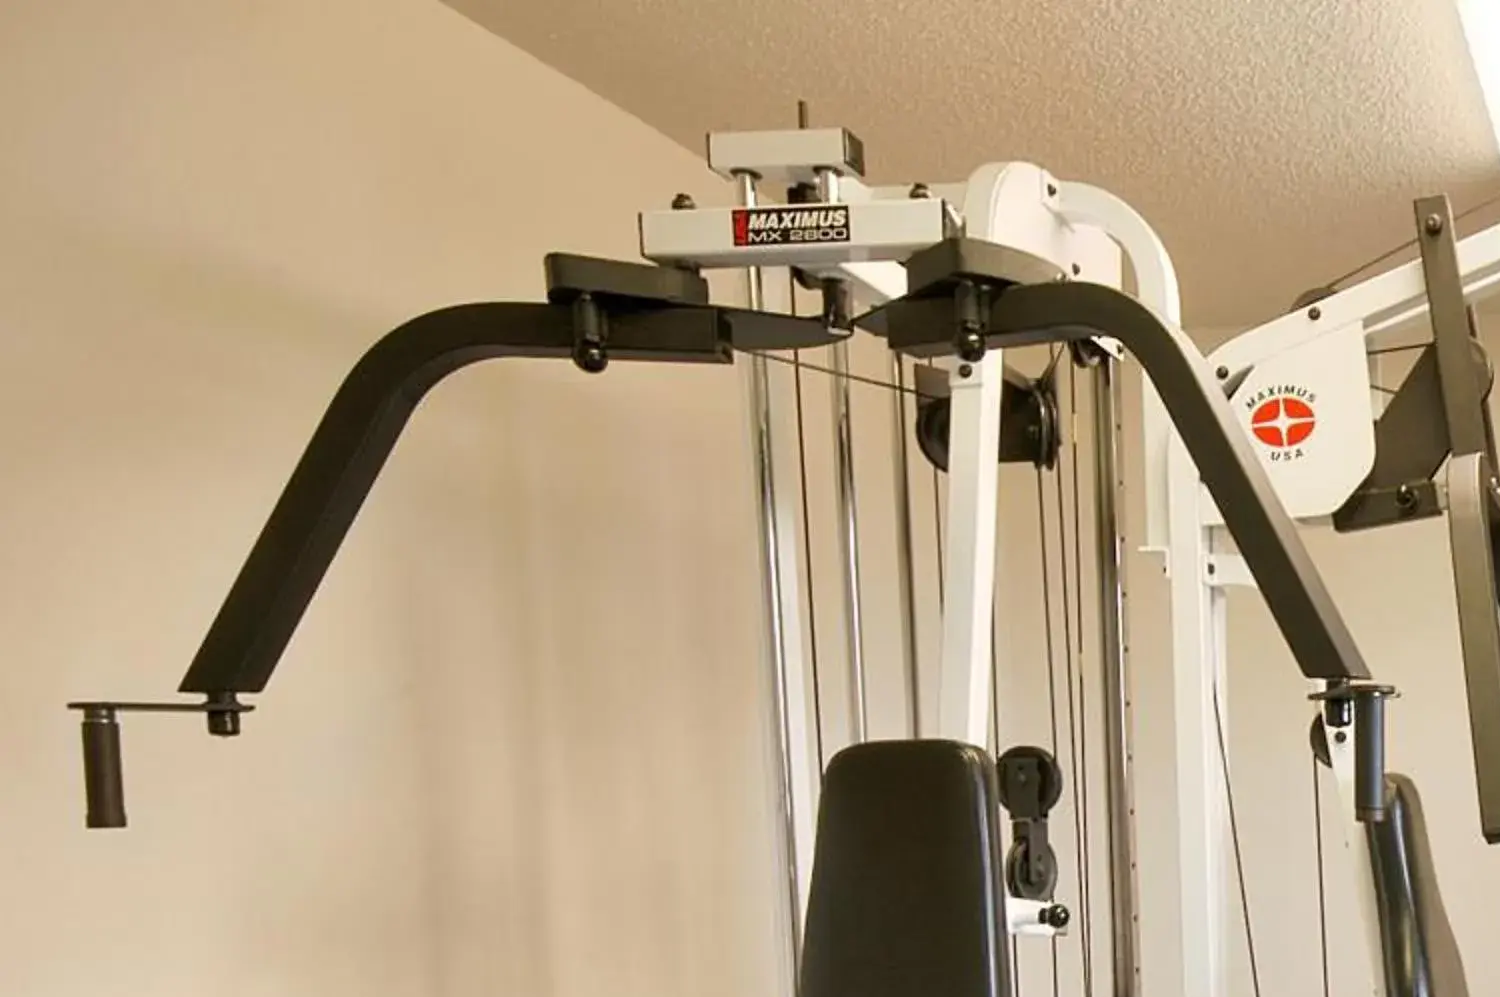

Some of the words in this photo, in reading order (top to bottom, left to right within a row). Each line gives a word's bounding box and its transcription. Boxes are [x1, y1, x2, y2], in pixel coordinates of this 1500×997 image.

[748, 209, 847, 230] MAXIMUS
[748, 231, 782, 243] MX
[1245, 385, 1316, 410] MAXIMUS
[1271, 448, 1304, 462] USA
